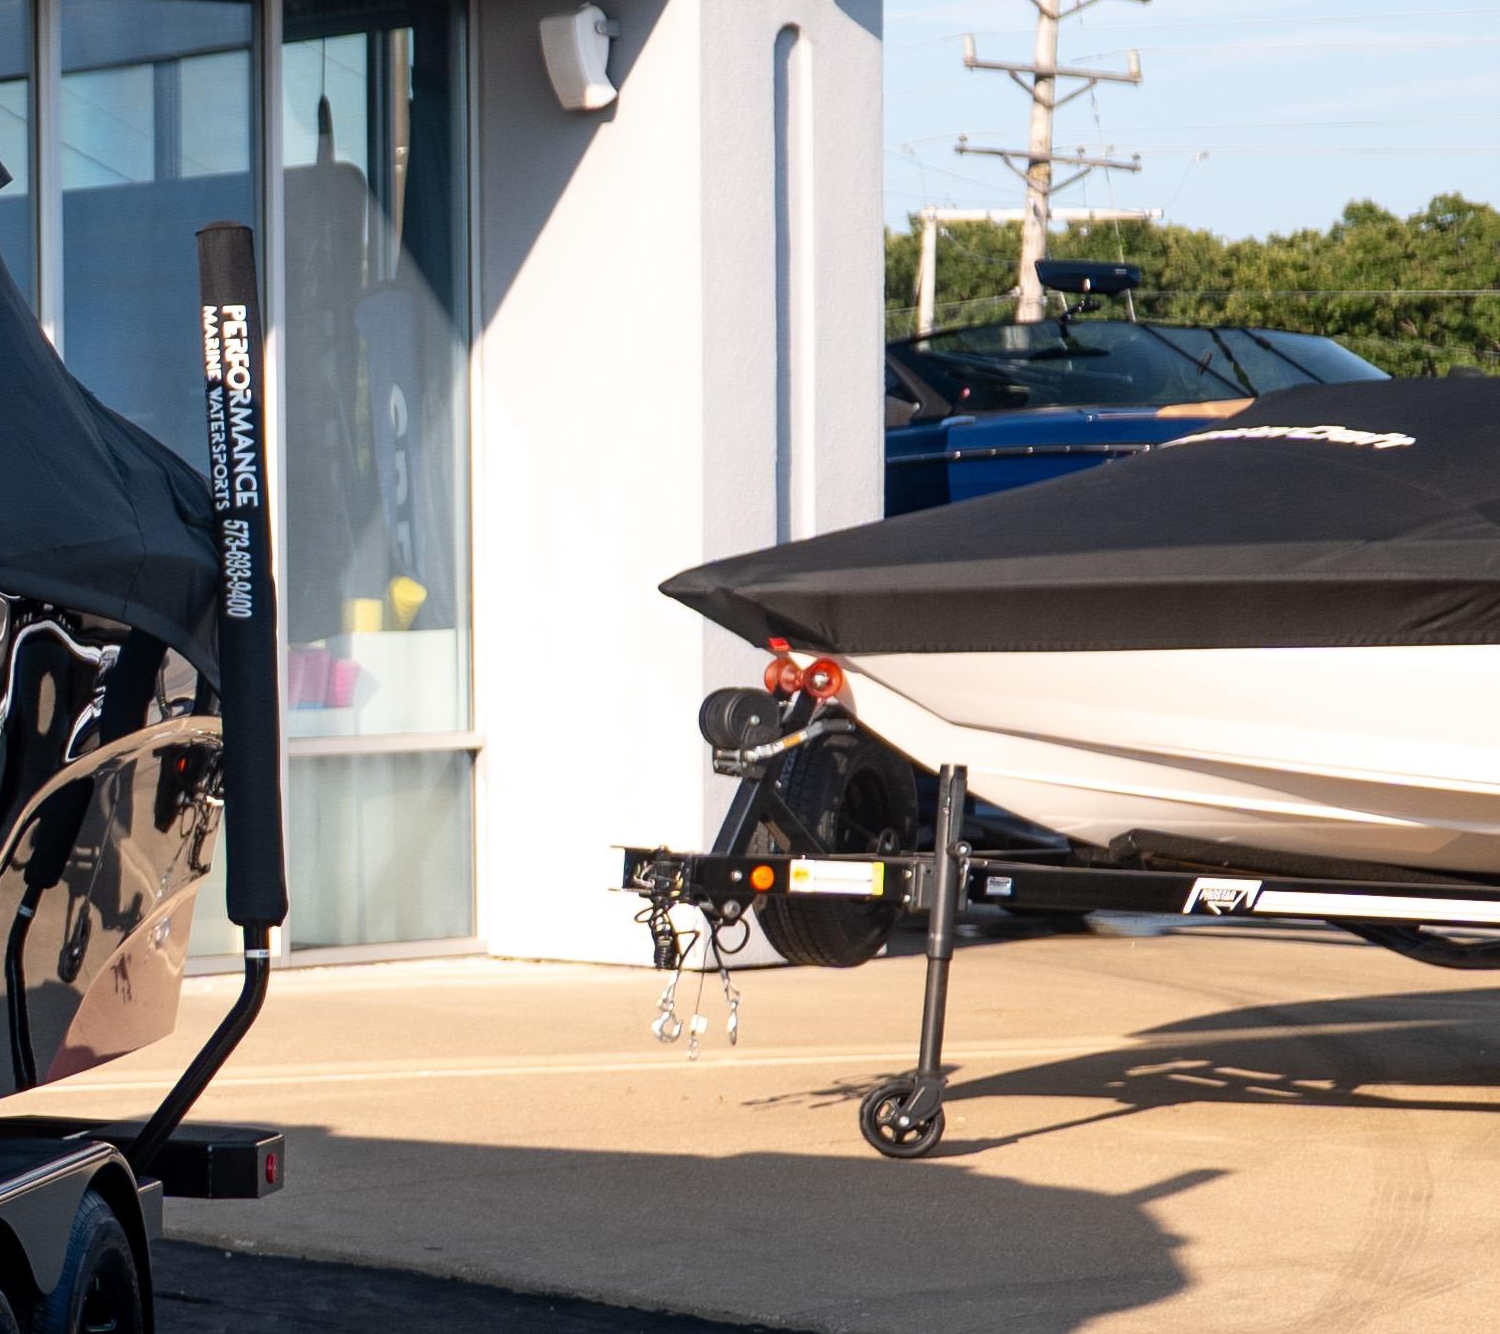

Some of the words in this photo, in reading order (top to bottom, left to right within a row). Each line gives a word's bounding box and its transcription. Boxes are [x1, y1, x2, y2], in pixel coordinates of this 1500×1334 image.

[203, 305, 223, 382] MARINE
[209, 386, 230, 512] WATERSPORTS
[222, 304, 259, 508] PERFORMANCE
[223, 519, 253, 618] 573-693-9400
